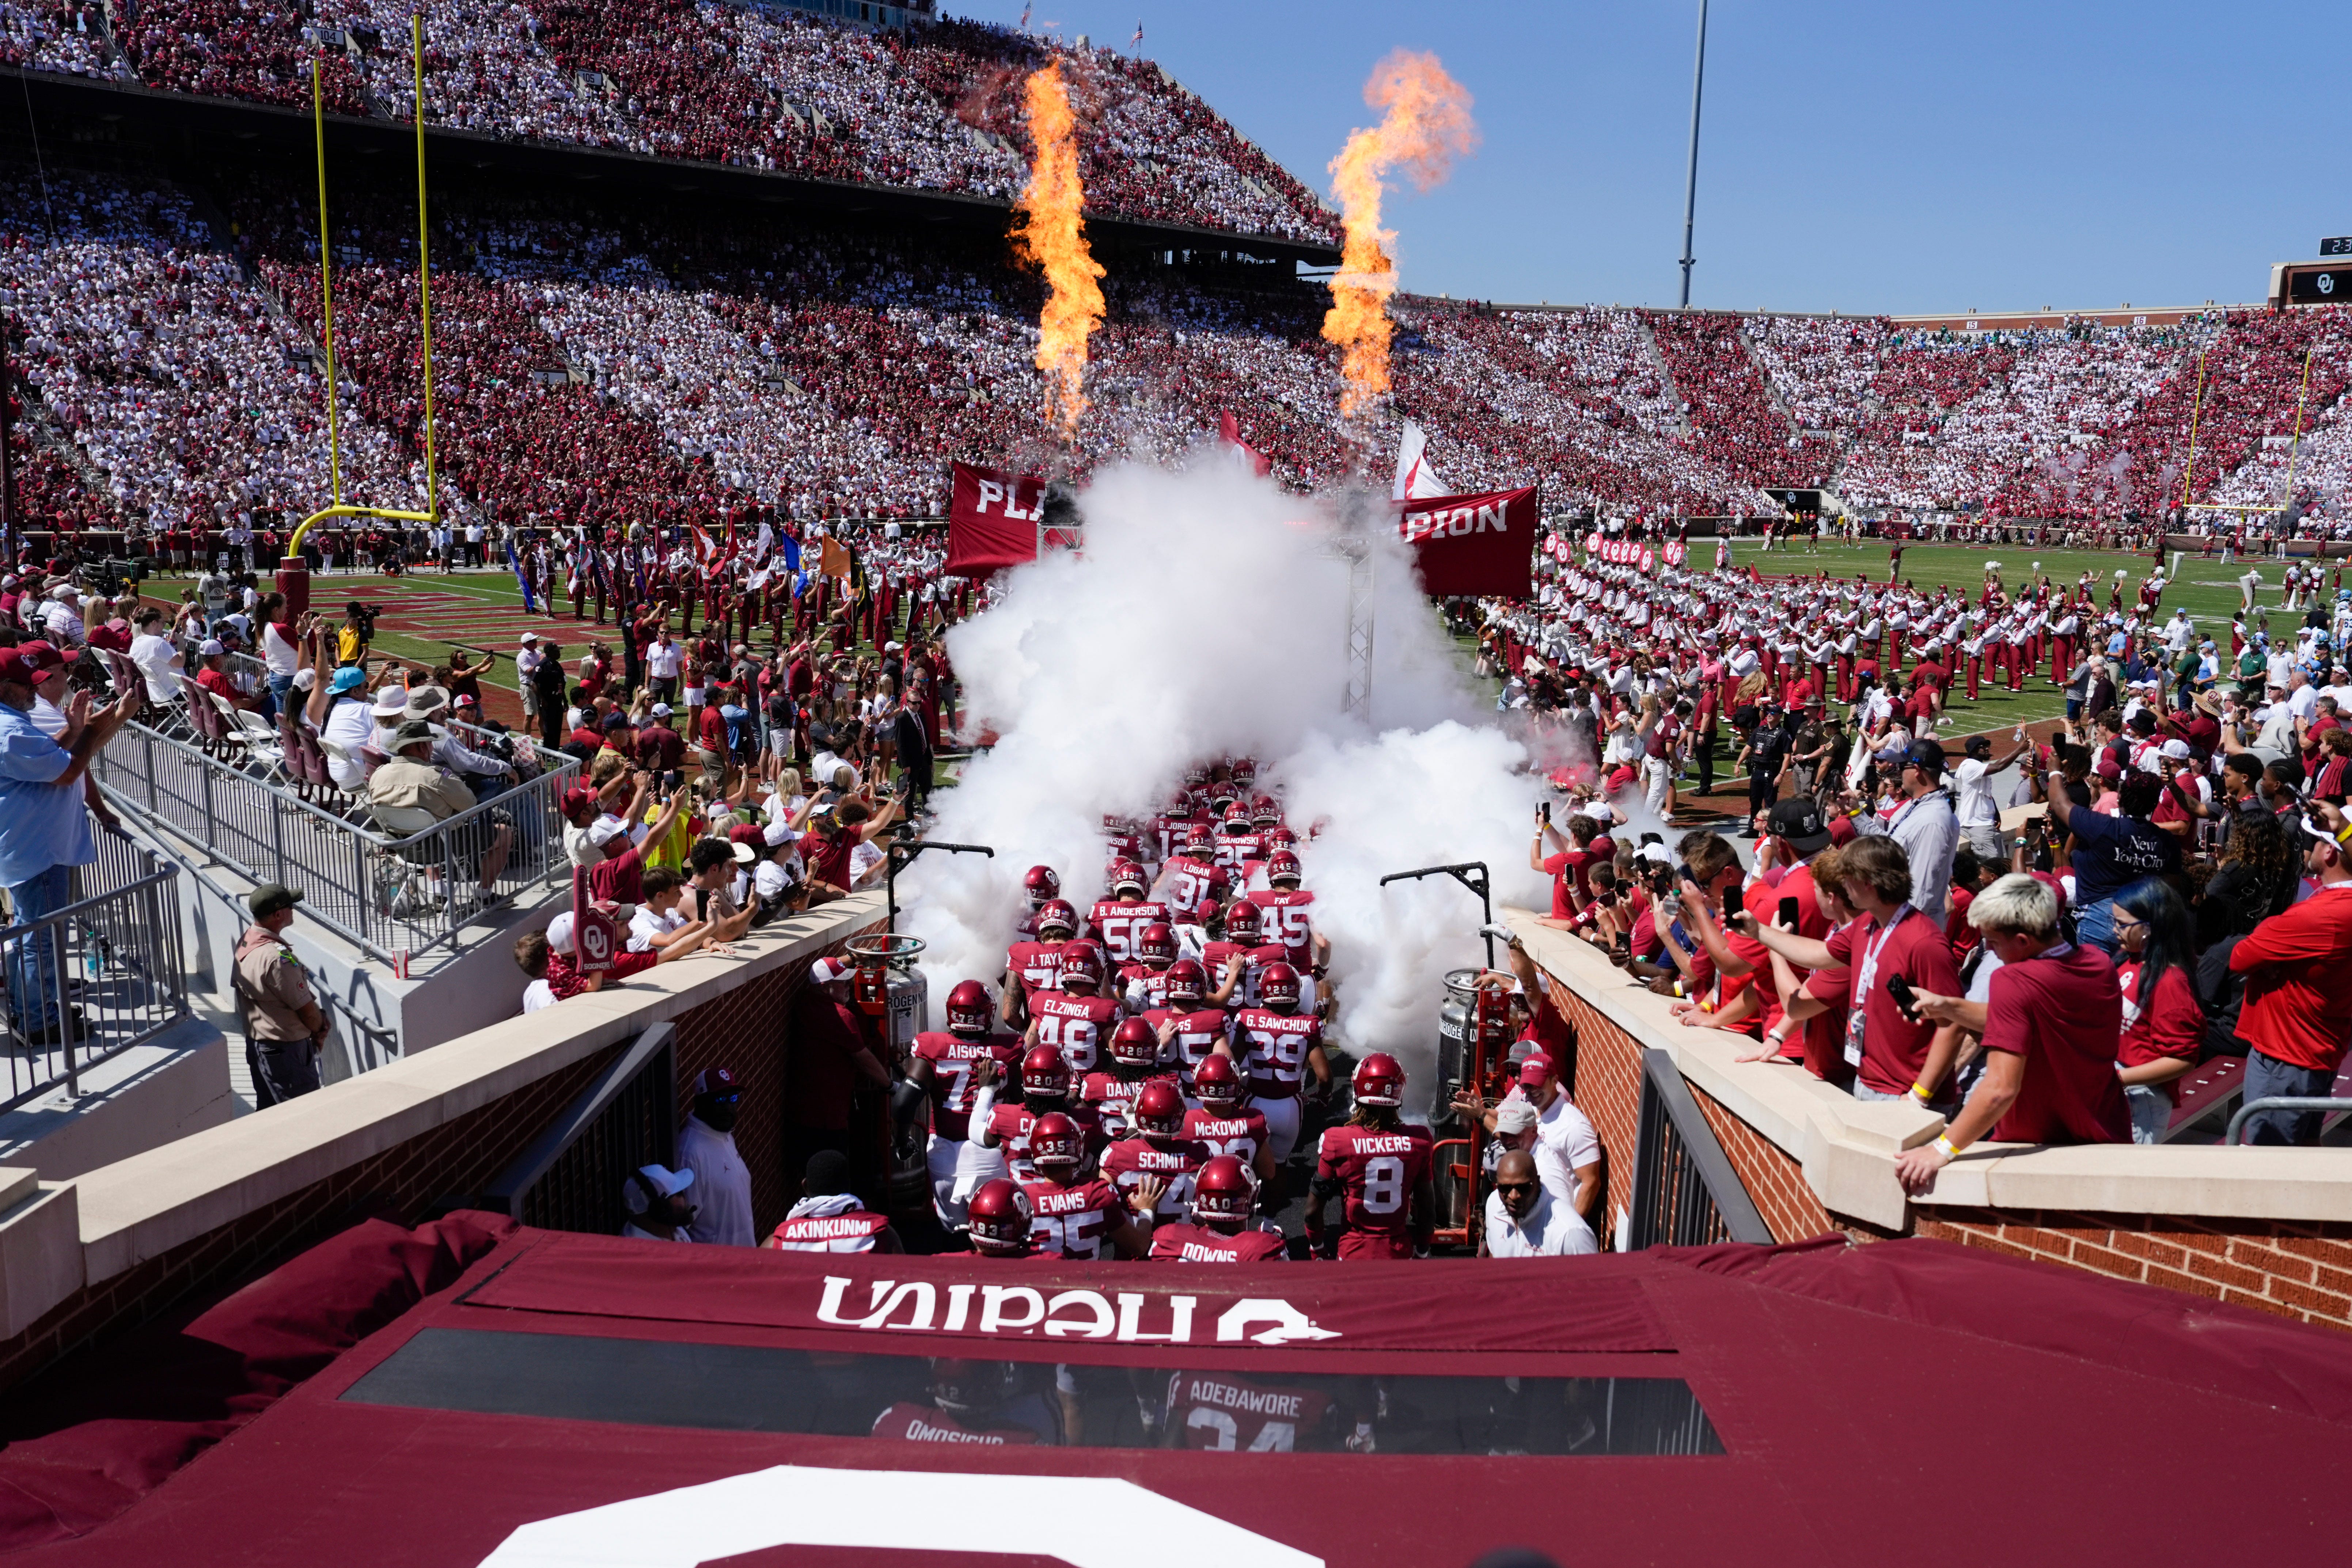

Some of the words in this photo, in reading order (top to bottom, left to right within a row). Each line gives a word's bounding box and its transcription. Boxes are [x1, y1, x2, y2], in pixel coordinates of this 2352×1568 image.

[320, 31, 335, 41] 104
[583, 73, 594, 83] 105
[2317, 274, 2334, 293] OU
[1787, 492, 1796, 503] OU
[1546, 534, 1556, 550] OU
[1588, 534, 1599, 550] OU
[2238, 537, 2245, 547] OU
[1557, 543, 1567, 561] OU
[1631, 544, 1640, 561] OU
[1673, 546, 1681, 564] OU
[1642, 551, 1651, 570] OU
[2207, 690, 2218, 704] OU
[2129, 835, 2157, 851] New
[2114, 847, 2141, 866] York
[2142, 854, 2165, 869] City
[1183, 863, 1210, 877] LOGAN
[1172, 873, 1210, 913] 31
[1274, 896, 1290, 904] FAY
[1100, 907, 1108, 916] B.
[1110, 906, 1159, 916] ANDERSON
[1263, 906, 1309, 947] 45
[584, 925, 608, 959] OU
[1148, 946, 1161, 954] 98
[584, 961, 610, 969] SOONERS
[1028, 955, 1037, 967] J.
[1068, 961, 1083, 971] 48
[1177, 982, 1191, 991] 25
[1043, 999, 1090, 1018] ELZINGA
[959, 1014, 974, 1024] 72
[1247, 1015, 1256, 1027] G.
[1258, 1016, 1311, 1033] SAWCHUK
[948, 1045, 993, 1059] AISOSA
[1127, 1046, 1143, 1056] 28
[1245, 1030, 1308, 1081] 29
[1035, 1076, 1052, 1085] 20
[1209, 1086, 1225, 1096] 22
[1385, 1084, 1392, 1095] 8
[1151, 1122, 1168, 1131] 34
[1195, 1120, 1248, 1136] McKOWN
[1046, 1141, 1065, 1152] 35
[1352, 1136, 1411, 1153] VICKERS
[1139, 1152, 1185, 1169] SCHMIT
[1363, 1156, 1404, 1214] 8
[1039, 1192, 1085, 1213] EVANS
[1209, 1197, 1230, 1210] 40
[786, 1219, 871, 1238] AKINKUNMI
[978, 1222, 998, 1236] 93
[1190, 1380, 1302, 1418] ADEBAWORE
